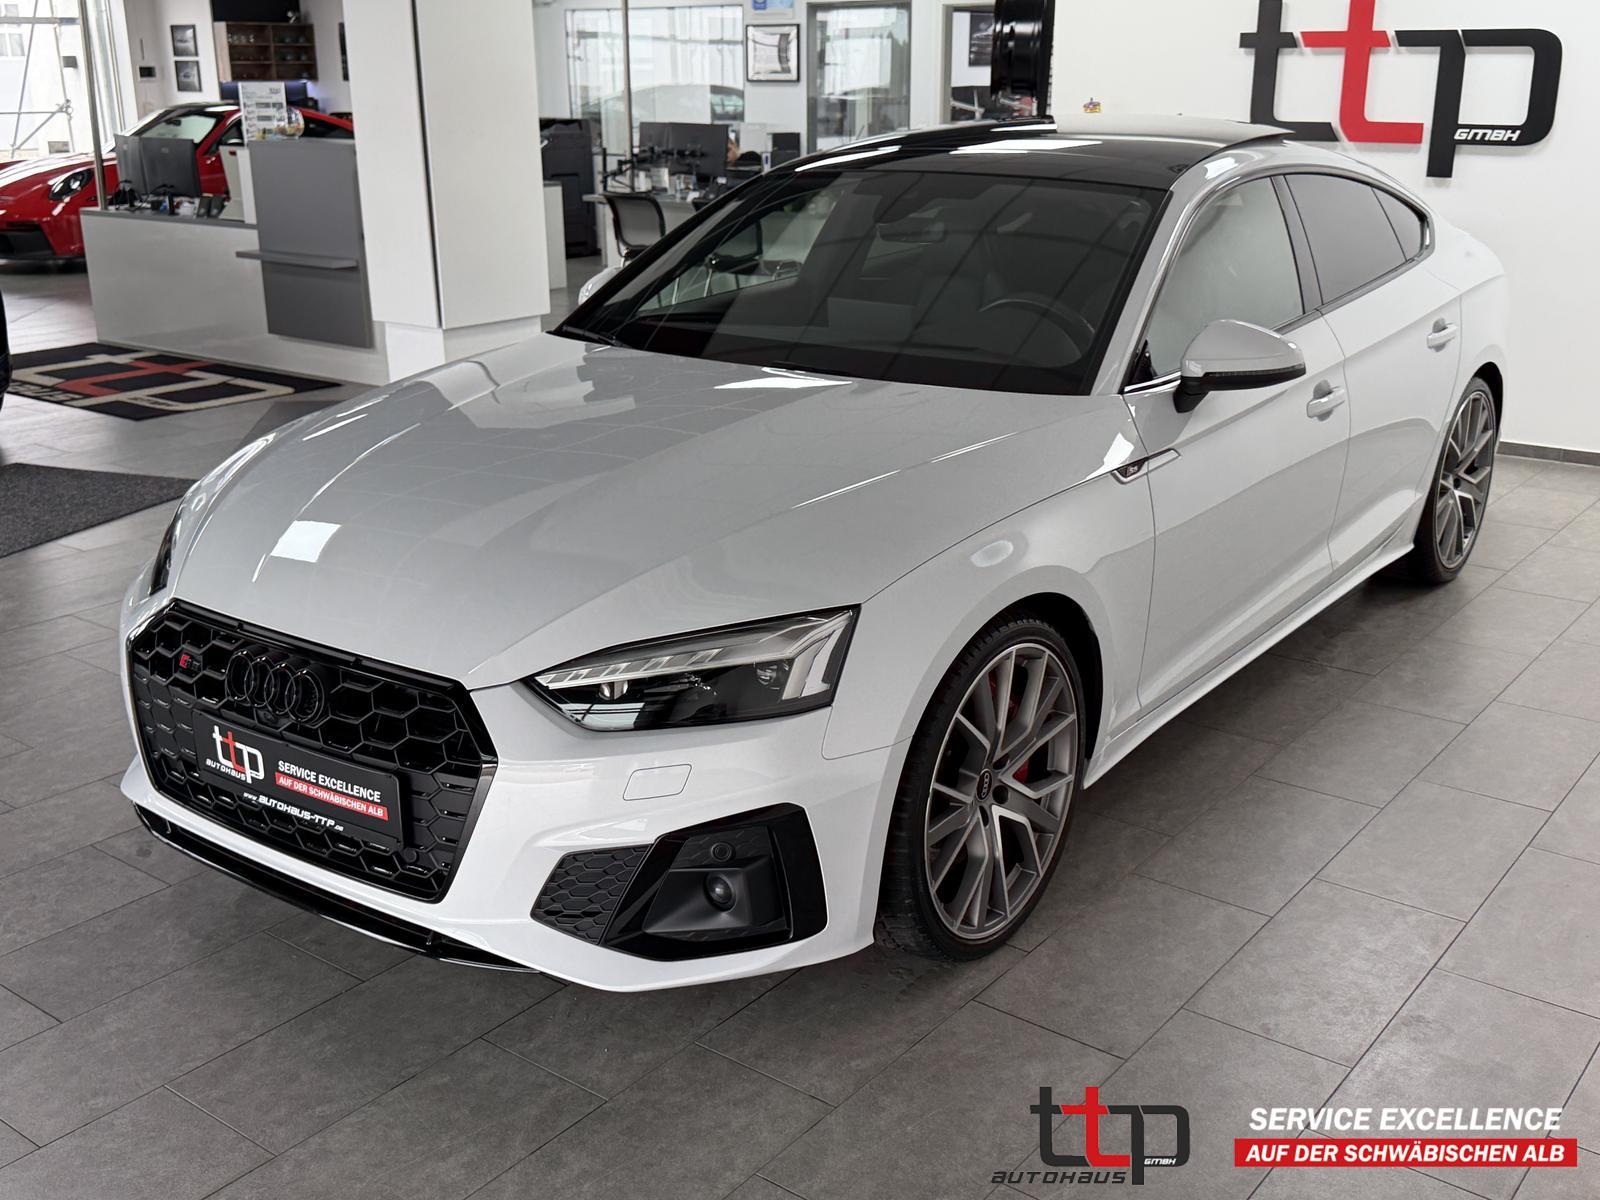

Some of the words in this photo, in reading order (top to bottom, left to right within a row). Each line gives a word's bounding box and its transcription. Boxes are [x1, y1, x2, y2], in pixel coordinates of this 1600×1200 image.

[278, 760, 317, 783] SERVICE
[318, 774, 382, 803] EXCELLENCE
[279, 776, 293, 789] AUF
[293, 781, 308, 793] DER
[368, 805, 384, 817] ALB
